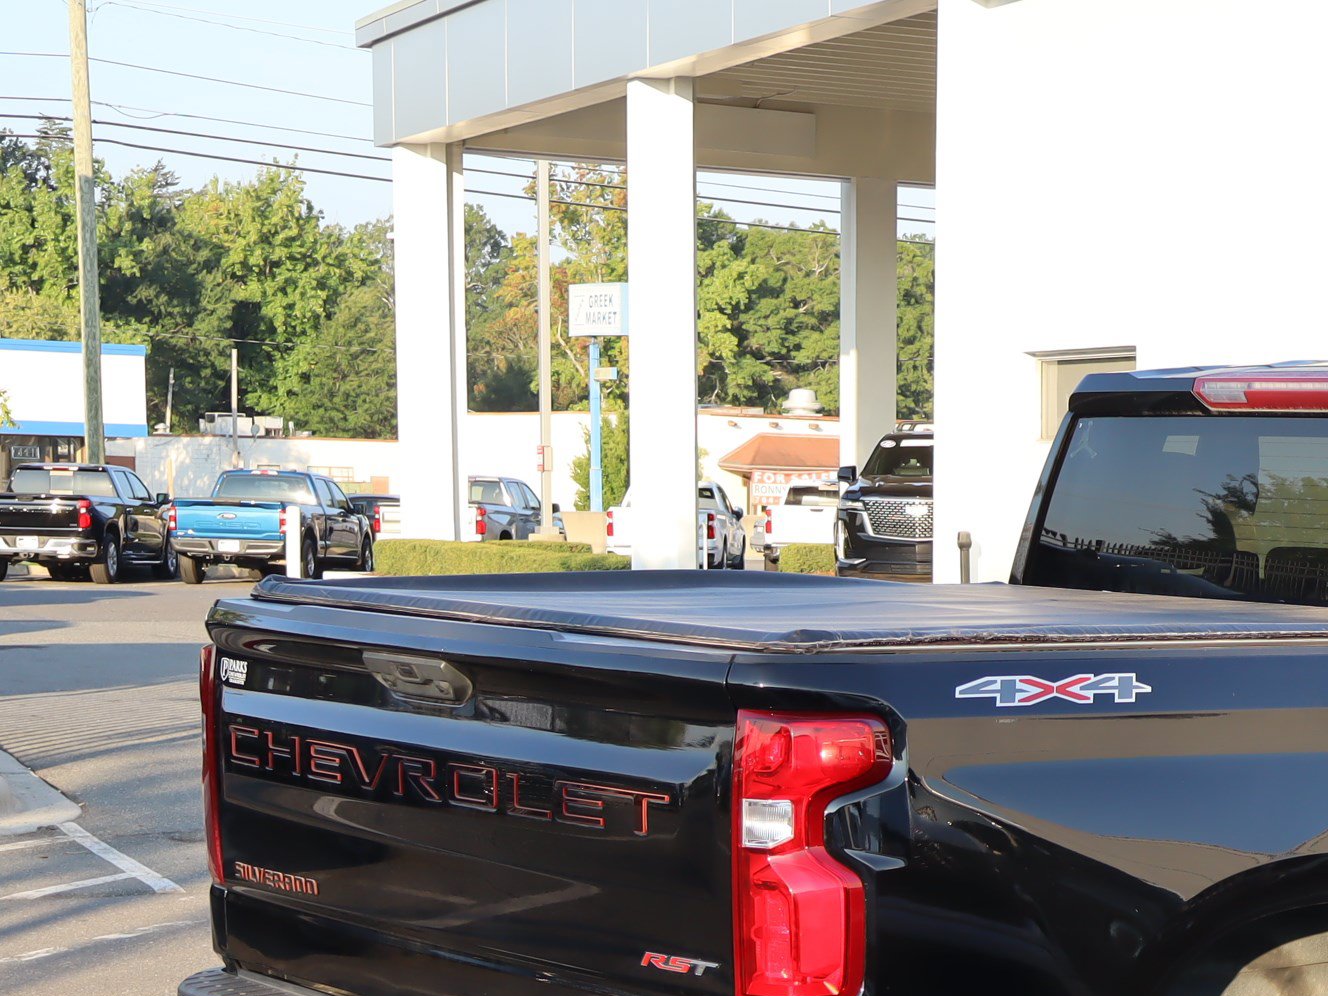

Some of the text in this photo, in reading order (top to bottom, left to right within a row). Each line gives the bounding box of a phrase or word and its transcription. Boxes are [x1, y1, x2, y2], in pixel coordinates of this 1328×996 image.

[588, 293, 614, 309] GREEK
[585, 311, 618, 326] MARKET
[754, 472, 785, 483] FOR
[227, 723, 671, 837] CHEVROLET
[234, 860, 320, 897] SILVERADO
[641, 951, 720, 977] RST
